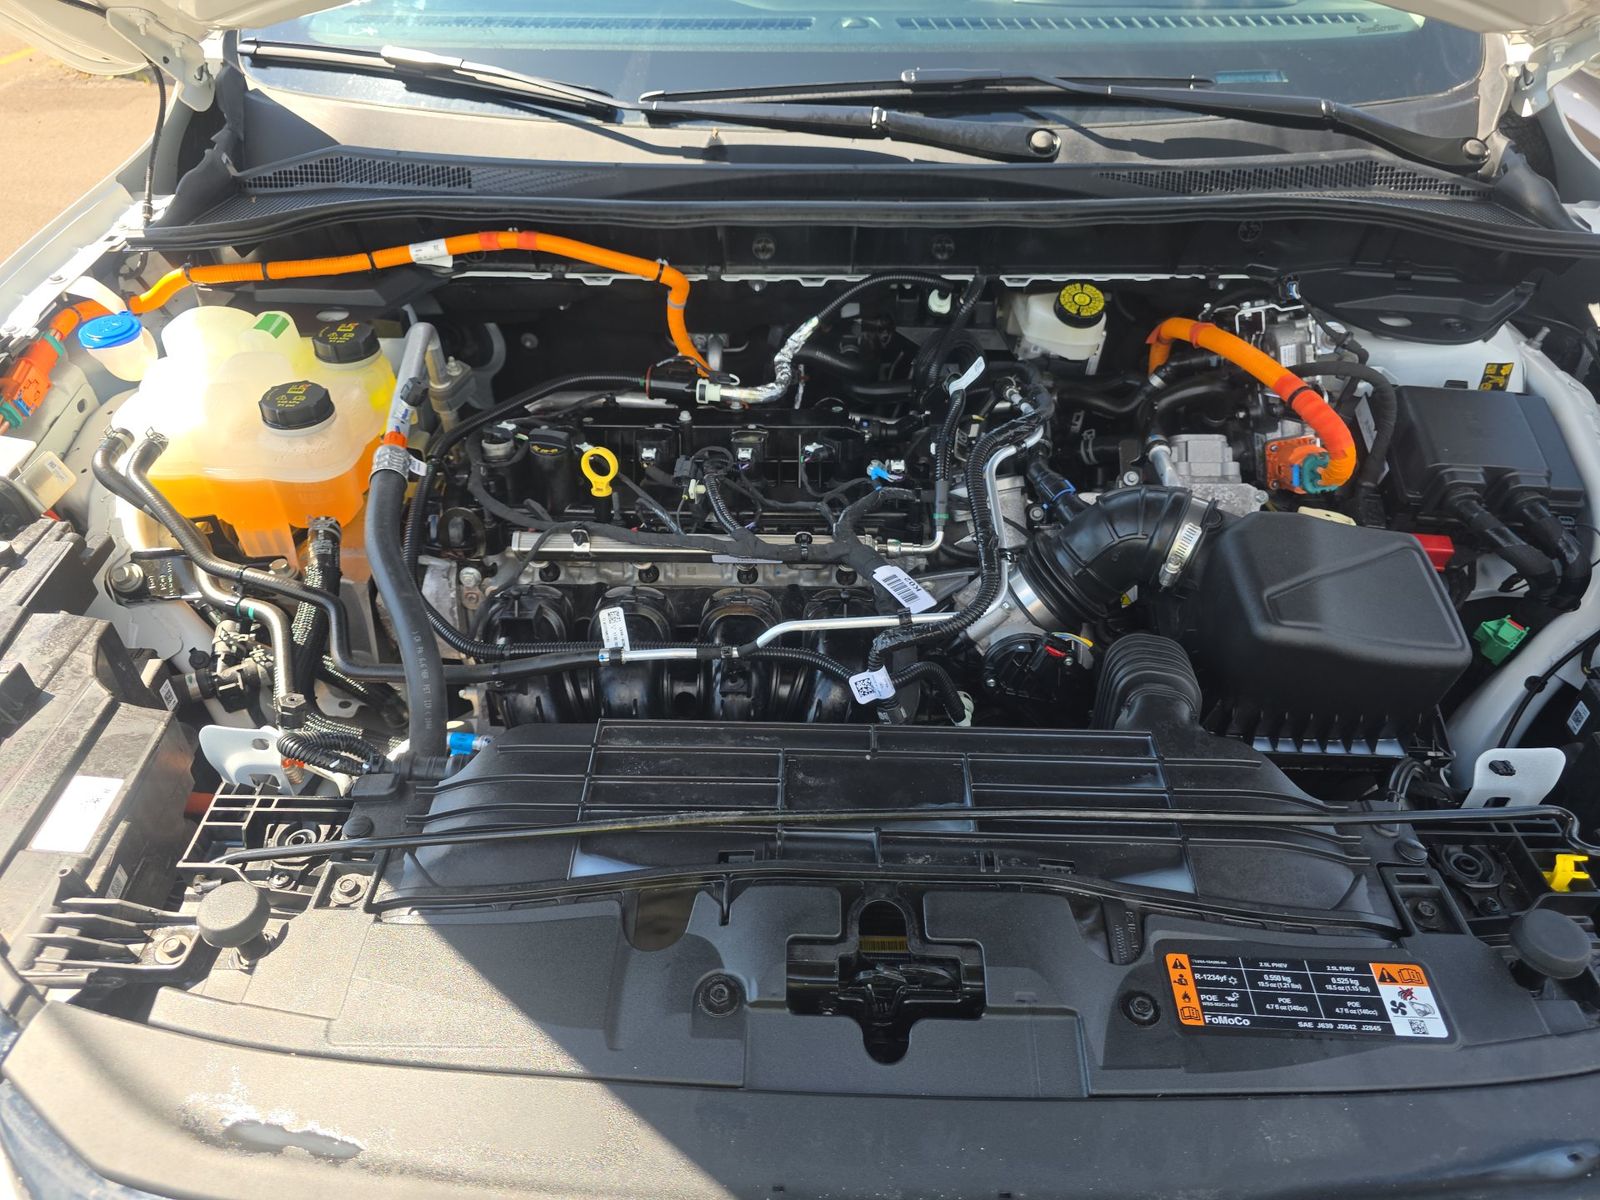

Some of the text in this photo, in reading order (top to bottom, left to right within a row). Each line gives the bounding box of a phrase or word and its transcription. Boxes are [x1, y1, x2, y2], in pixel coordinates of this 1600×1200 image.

[1195, 973, 1227, 982] R-1234yf
[1282, 975, 1291, 983] kg
[1349, 978, 1359, 986] kg
[1205, 1015, 1250, 1026] FoMoCo
